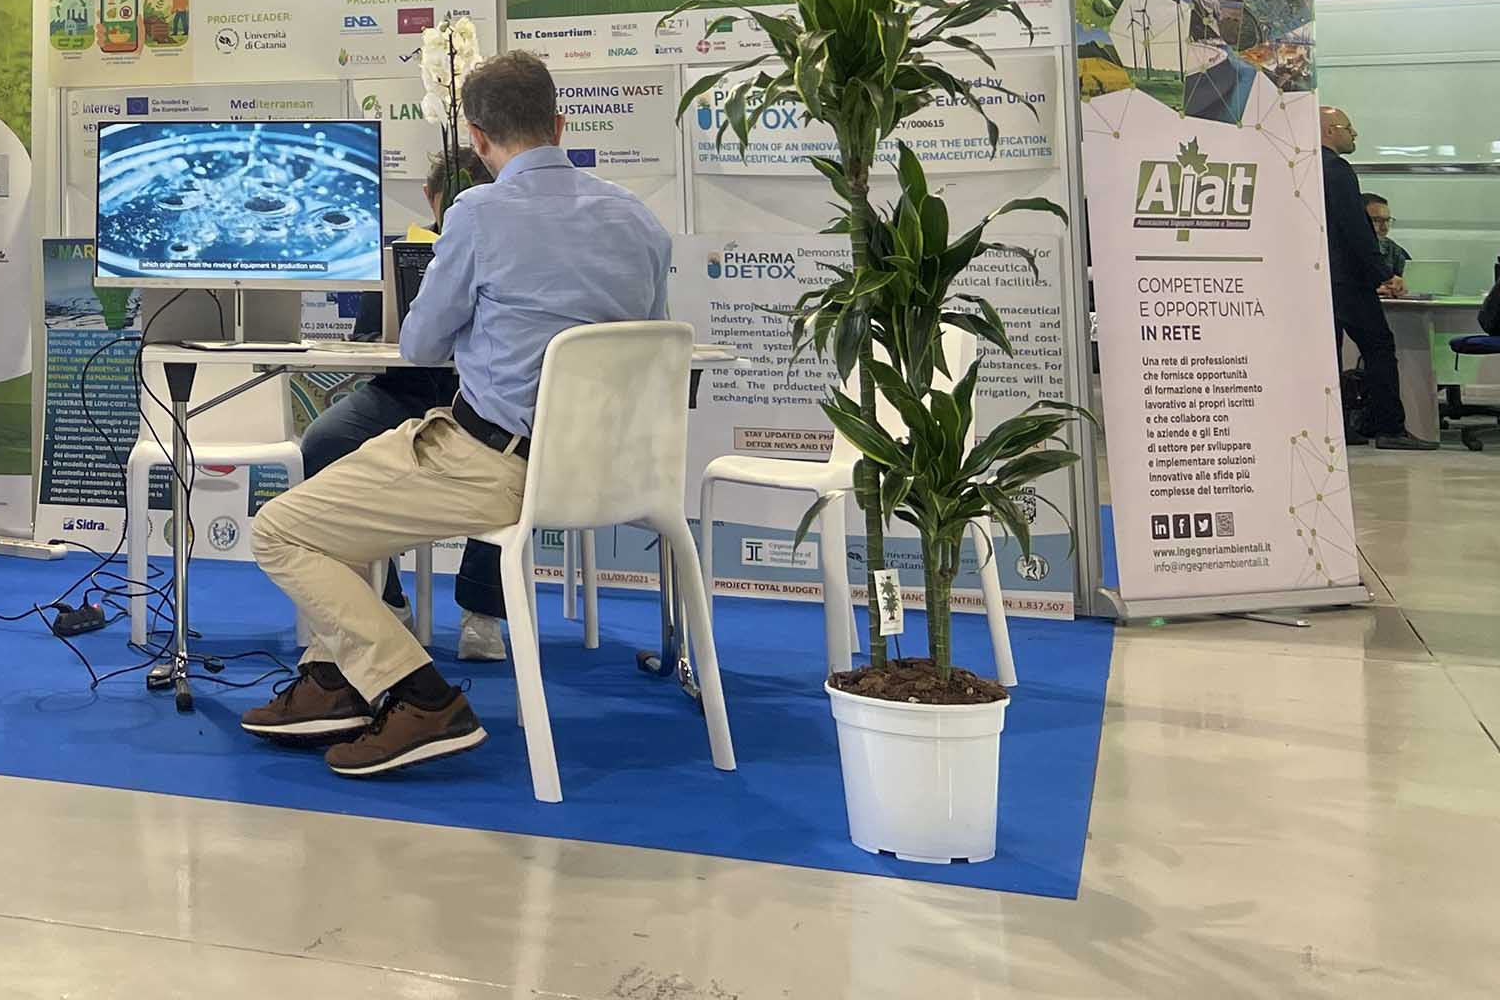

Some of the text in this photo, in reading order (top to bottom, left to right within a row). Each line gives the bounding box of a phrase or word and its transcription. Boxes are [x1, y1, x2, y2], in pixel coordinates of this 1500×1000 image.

[208, 13, 292, 24] PROJECT LEADER:
[344, 16, 378, 28] ENEA
[244, 31, 287, 40] Università
[514, 29, 597, 39] The Consortium:
[245, 41, 286, 50] di Catania
[622, 85, 663, 97] WASTE
[231, 99, 313, 110] Mediterranean
[916, 136, 960, 148] FOR THE
[1001, 147, 1052, 159] FACILITIES
[1137, 162, 1254, 215] Aiat
[724, 252, 795, 263] PHARMA
[724, 265, 795, 279] DETOX
[1138, 278, 1244, 293] COMPETENZE
[1140, 299, 1265, 317] E OPPORTUNITÀ
[1141, 326, 1201, 340] IN RETE
[1142, 356, 1248, 367] Una rete di professionisti
[1143, 370, 1247, 381] che fornisce opportunità
[1144, 386, 1152, 394] di
[1155, 385, 1202, 394] formazione
[1212, 384, 1263, 393] inserimento
[765, 431, 798, 439] UPDATED
[801, 432, 816, 440] ON
[1150, 485, 1254, 497] complesse del territorio.
[76, 519, 105, 531] Sidra
[1154, 543, 1271, 559] www.ingegneriambientali.it
[1154, 558, 1269, 574] info@ingegneriambientali.it
[714, 580, 751, 590] PROJECT
[753, 582, 780, 592] TOTAL
